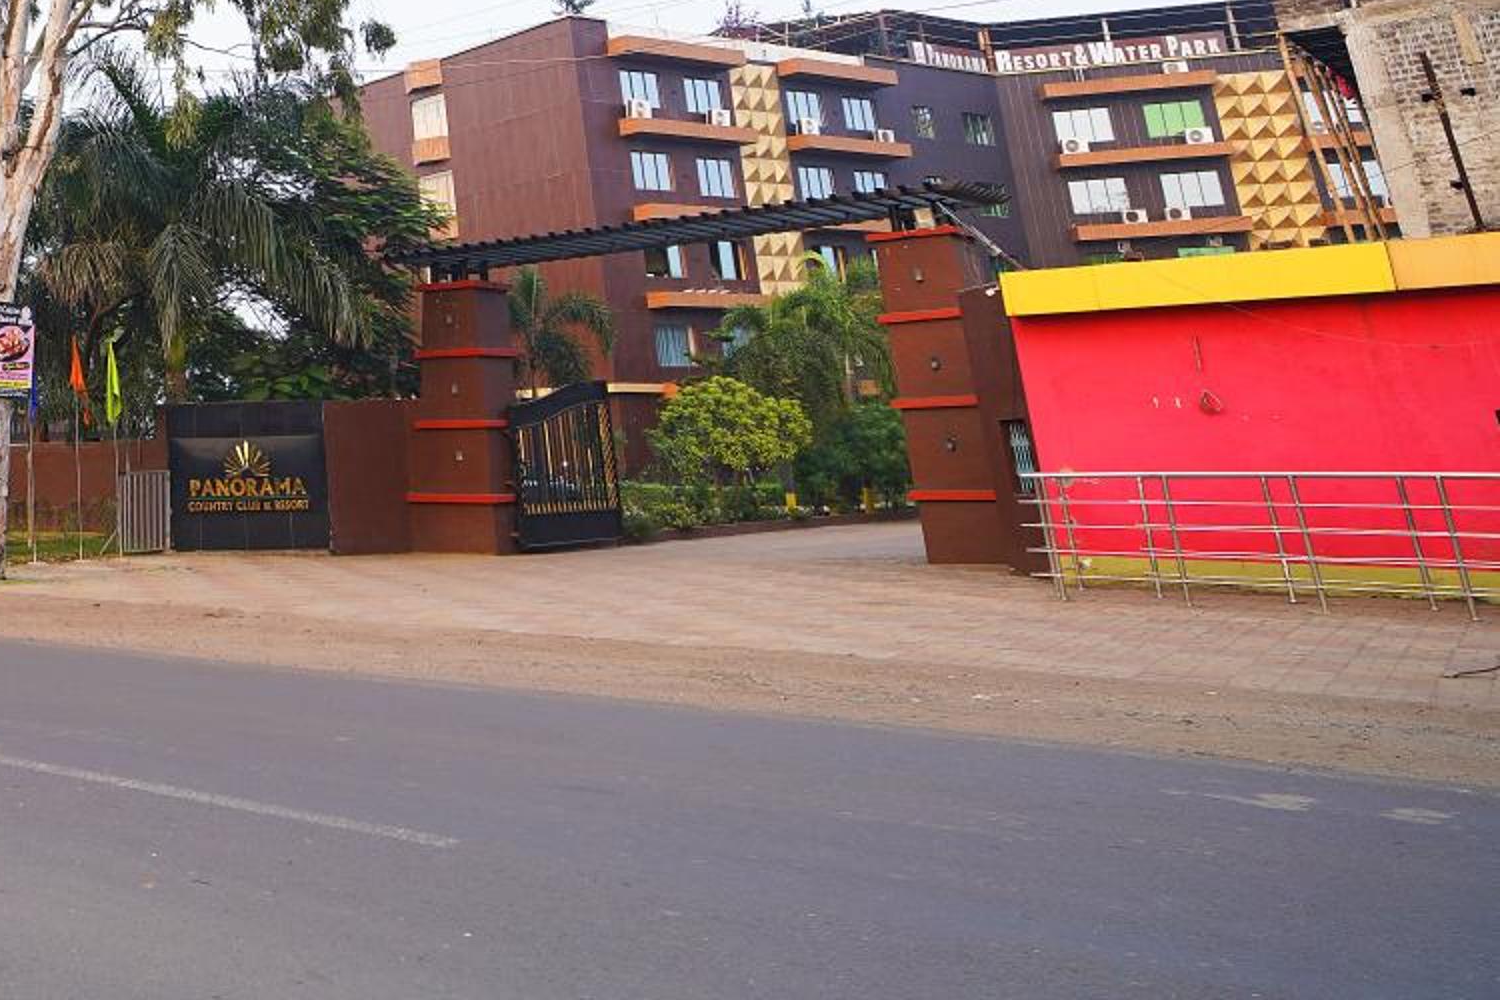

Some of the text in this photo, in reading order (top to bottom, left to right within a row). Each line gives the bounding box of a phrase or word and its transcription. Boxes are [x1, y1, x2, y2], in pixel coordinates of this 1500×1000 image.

[1165, 35, 1221, 57] PARK
[188, 477, 308, 498] PANORAMA
[187, 501, 234, 513] COUNTRY
[235, 500, 261, 512] CLUB
[275, 499, 309, 512] RESORT
